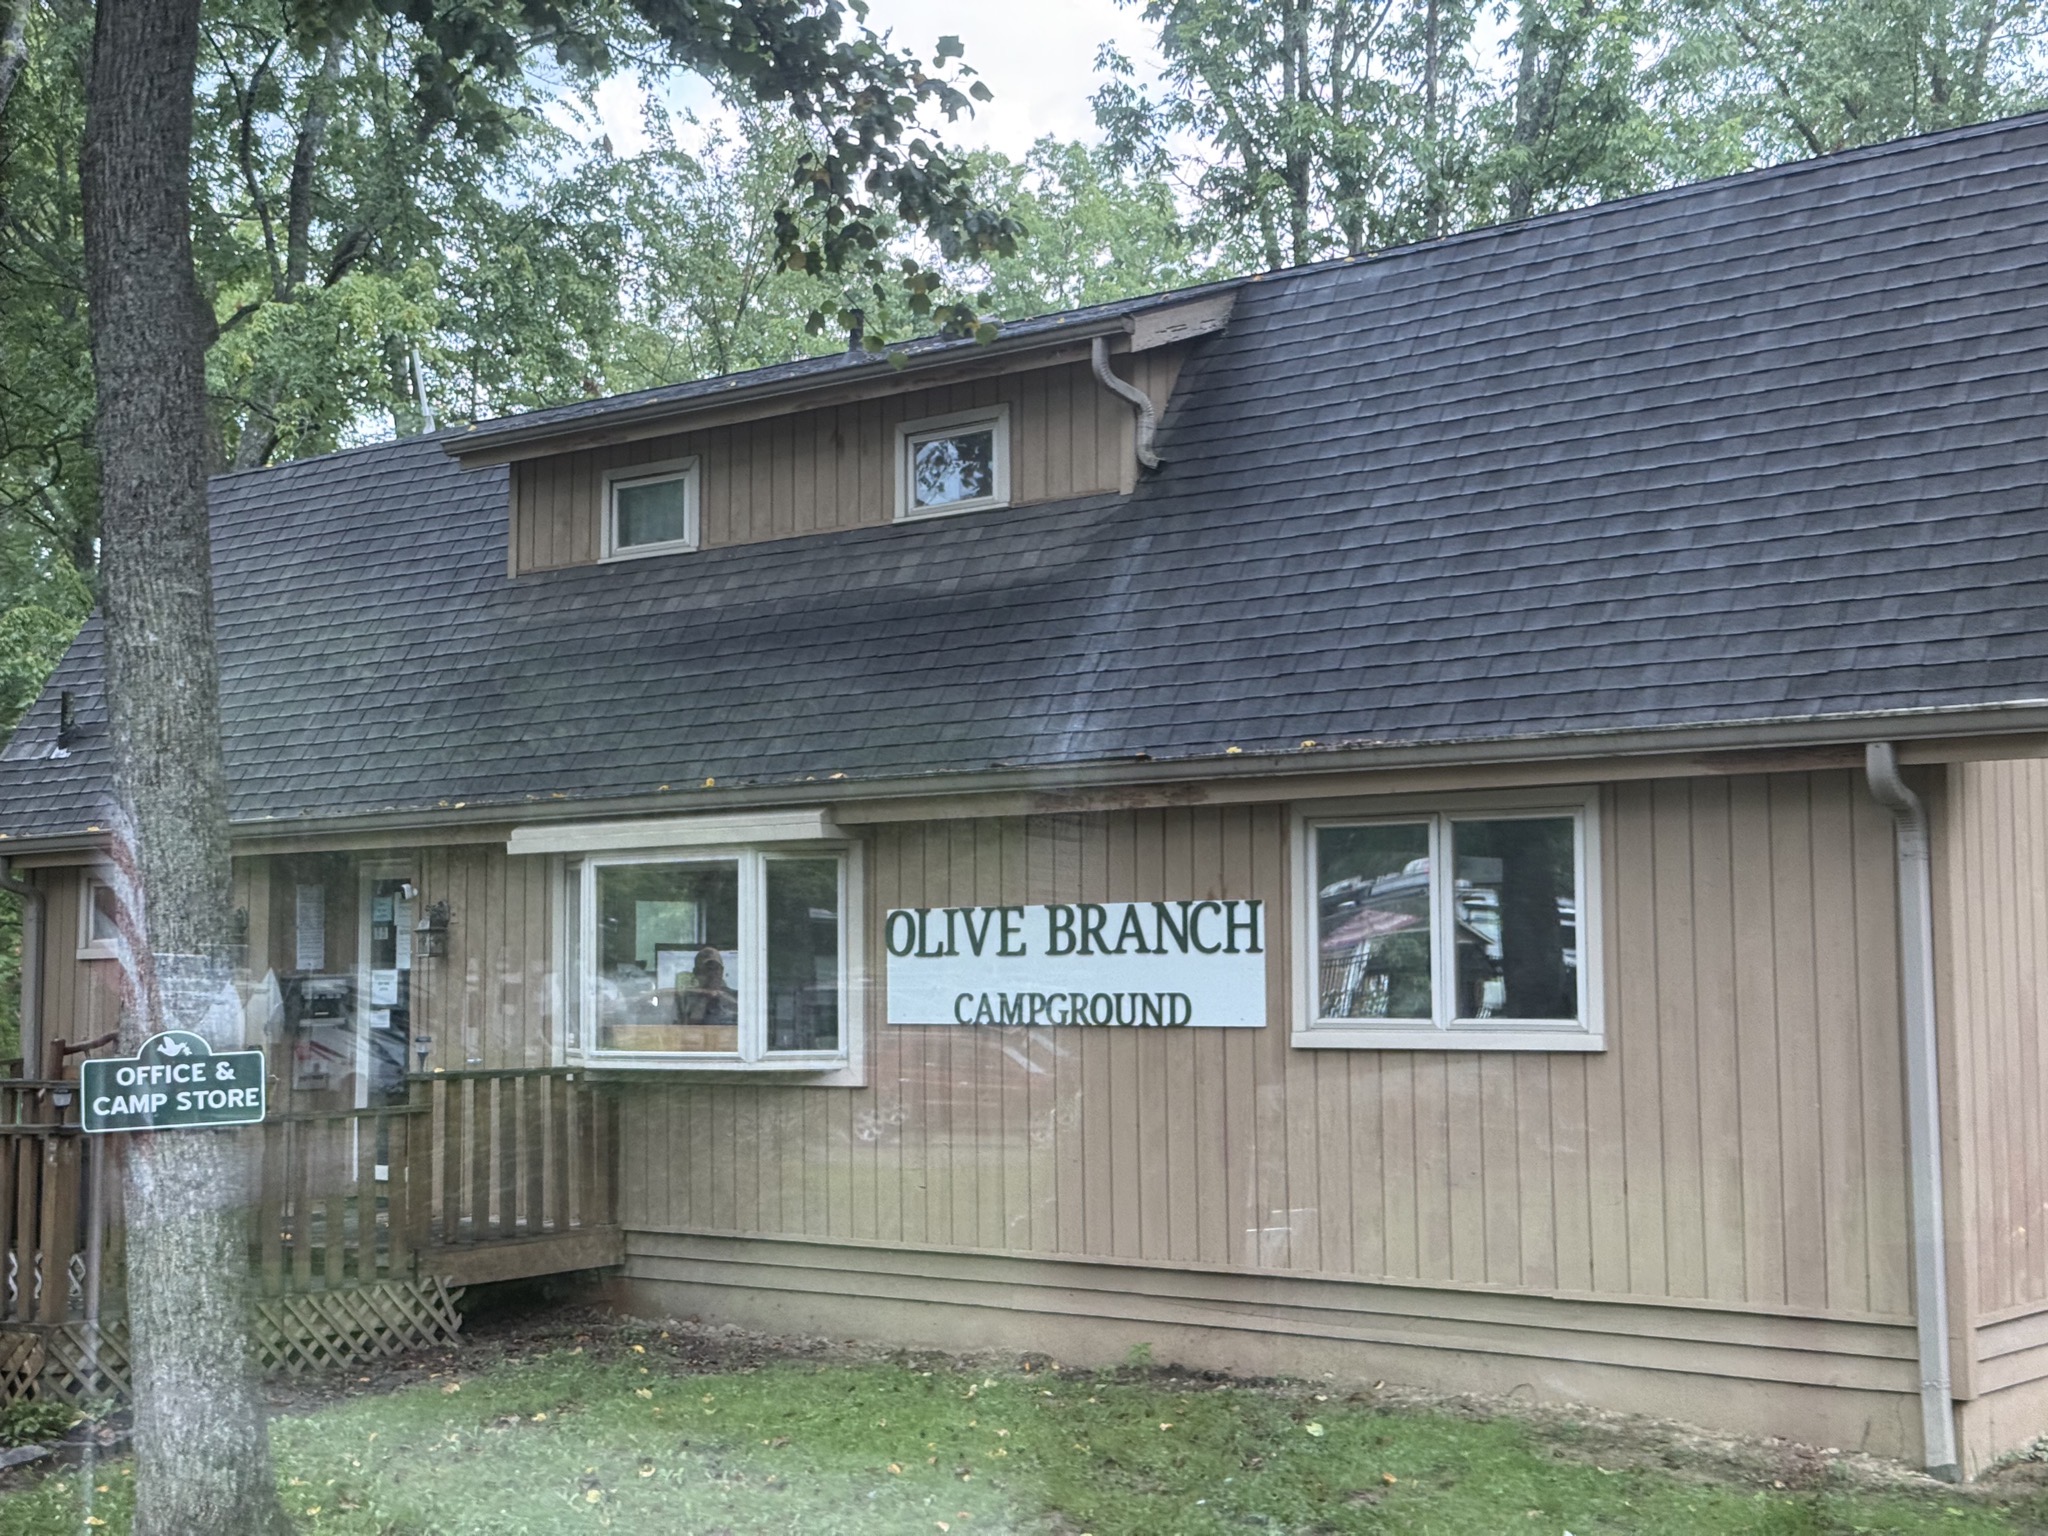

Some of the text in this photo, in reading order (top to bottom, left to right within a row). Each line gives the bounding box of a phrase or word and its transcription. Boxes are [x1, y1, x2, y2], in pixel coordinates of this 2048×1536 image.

[885, 900, 1264, 958] OLIVE BRANCH
[954, 992, 1192, 1027] CAMPGROUND
[116, 1061, 236, 1086] OFFICE &
[93, 1087, 260, 1116] CAMP STORE
